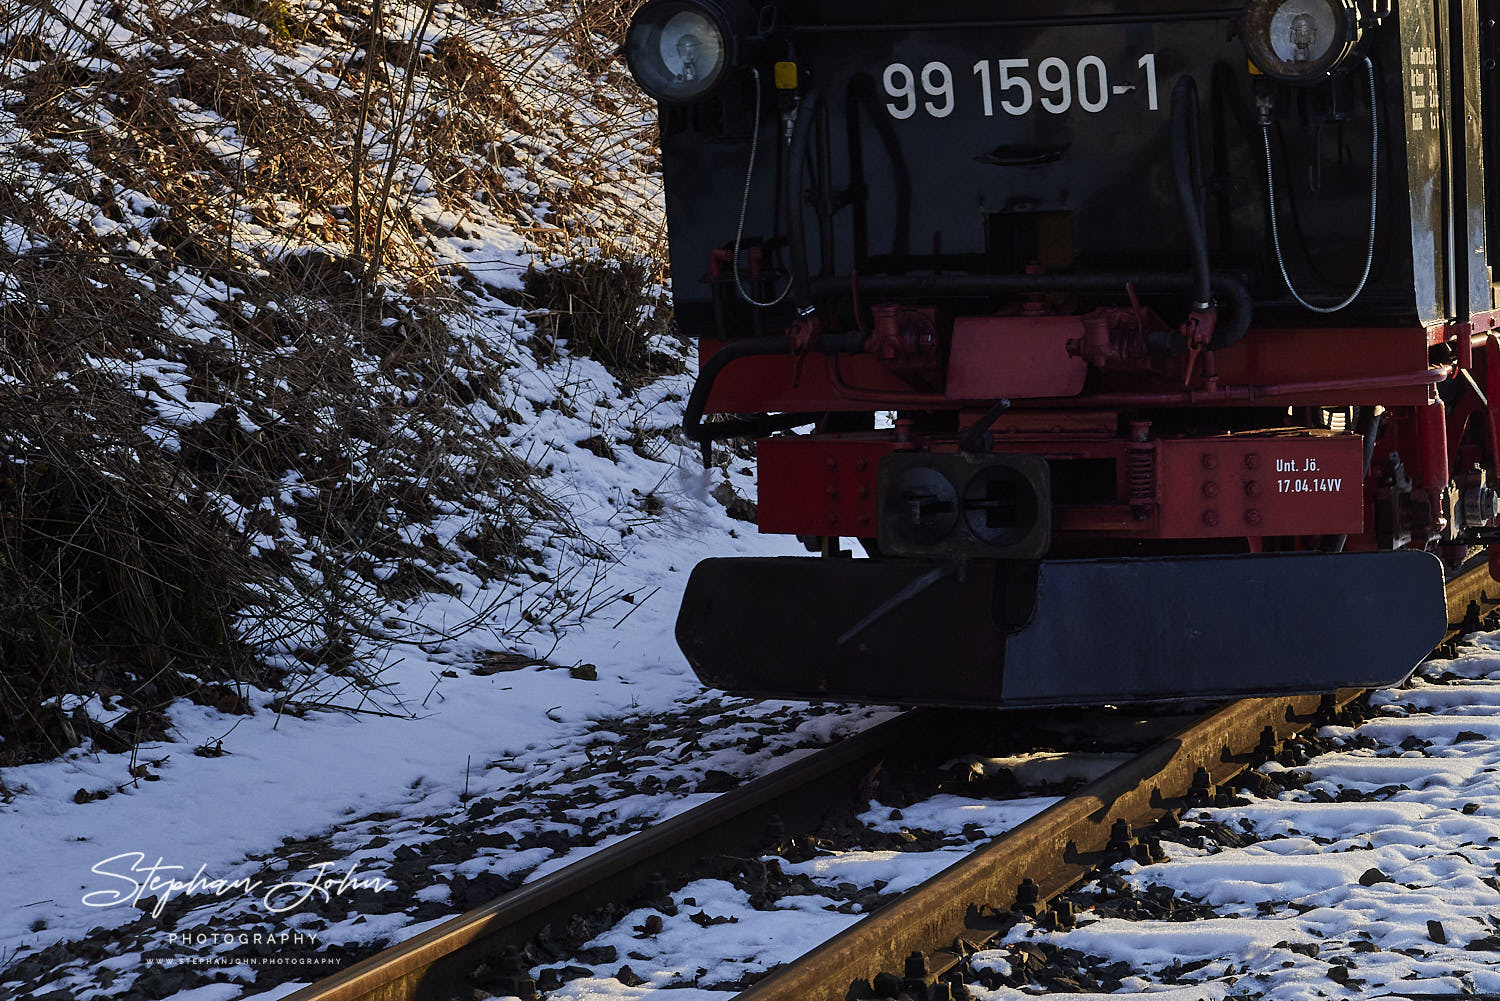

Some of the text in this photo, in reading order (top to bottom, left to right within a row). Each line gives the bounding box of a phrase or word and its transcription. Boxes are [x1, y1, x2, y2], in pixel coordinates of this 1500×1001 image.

[882, 53, 1159, 120] 99 1590-1
[1276, 457, 1320, 472] Unt. Jö.
[1277, 478, 1342, 493] 17.04.14VV
